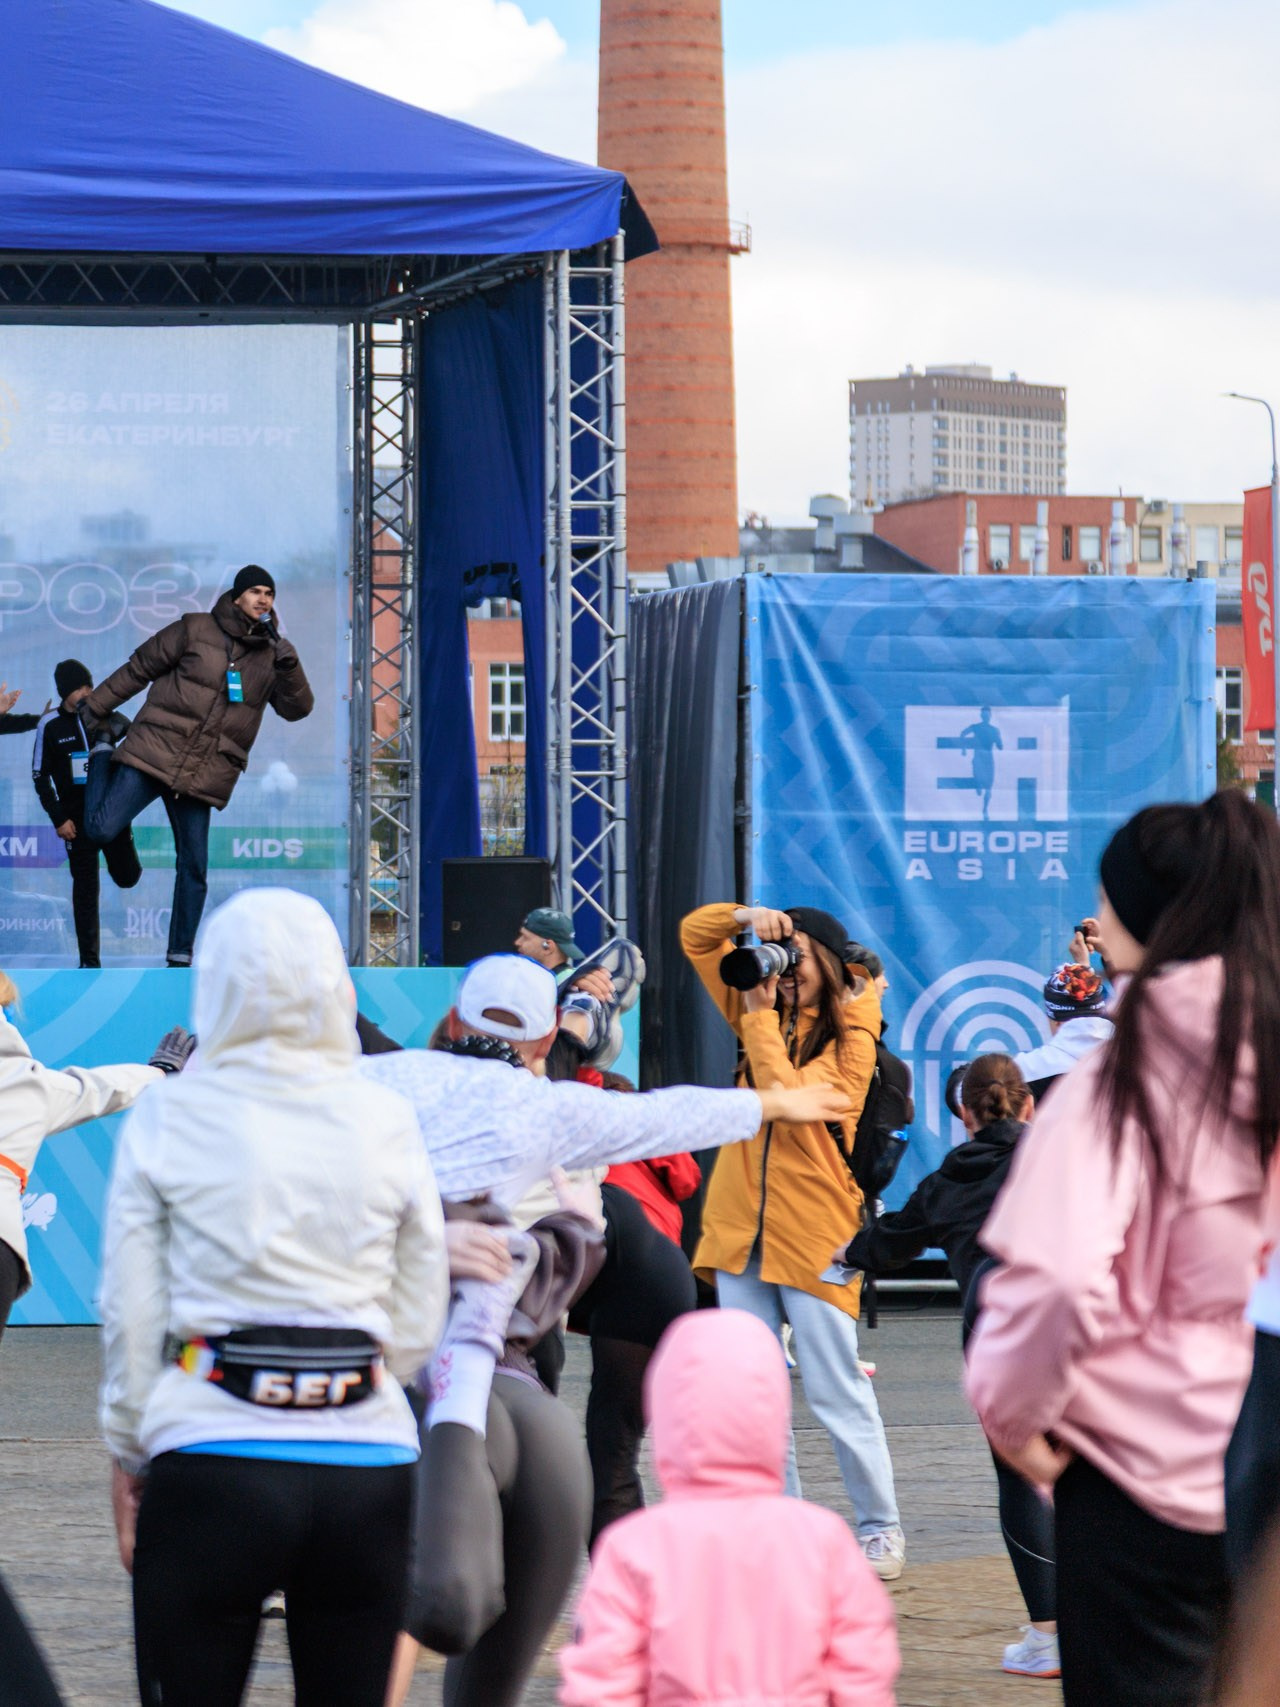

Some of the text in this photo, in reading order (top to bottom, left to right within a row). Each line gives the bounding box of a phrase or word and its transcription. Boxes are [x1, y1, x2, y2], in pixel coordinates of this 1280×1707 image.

[47, 391, 229, 414] 26 АПРЕЛЯ
[47, 425, 301, 447] ЕКАТЕРИНБУРГ
[232, 838, 304, 858] KIDS
[904, 831, 1069, 854] EUROPE
[904, 858, 1069, 881] ASIA
[250, 1369, 362, 1407] БЕГ
